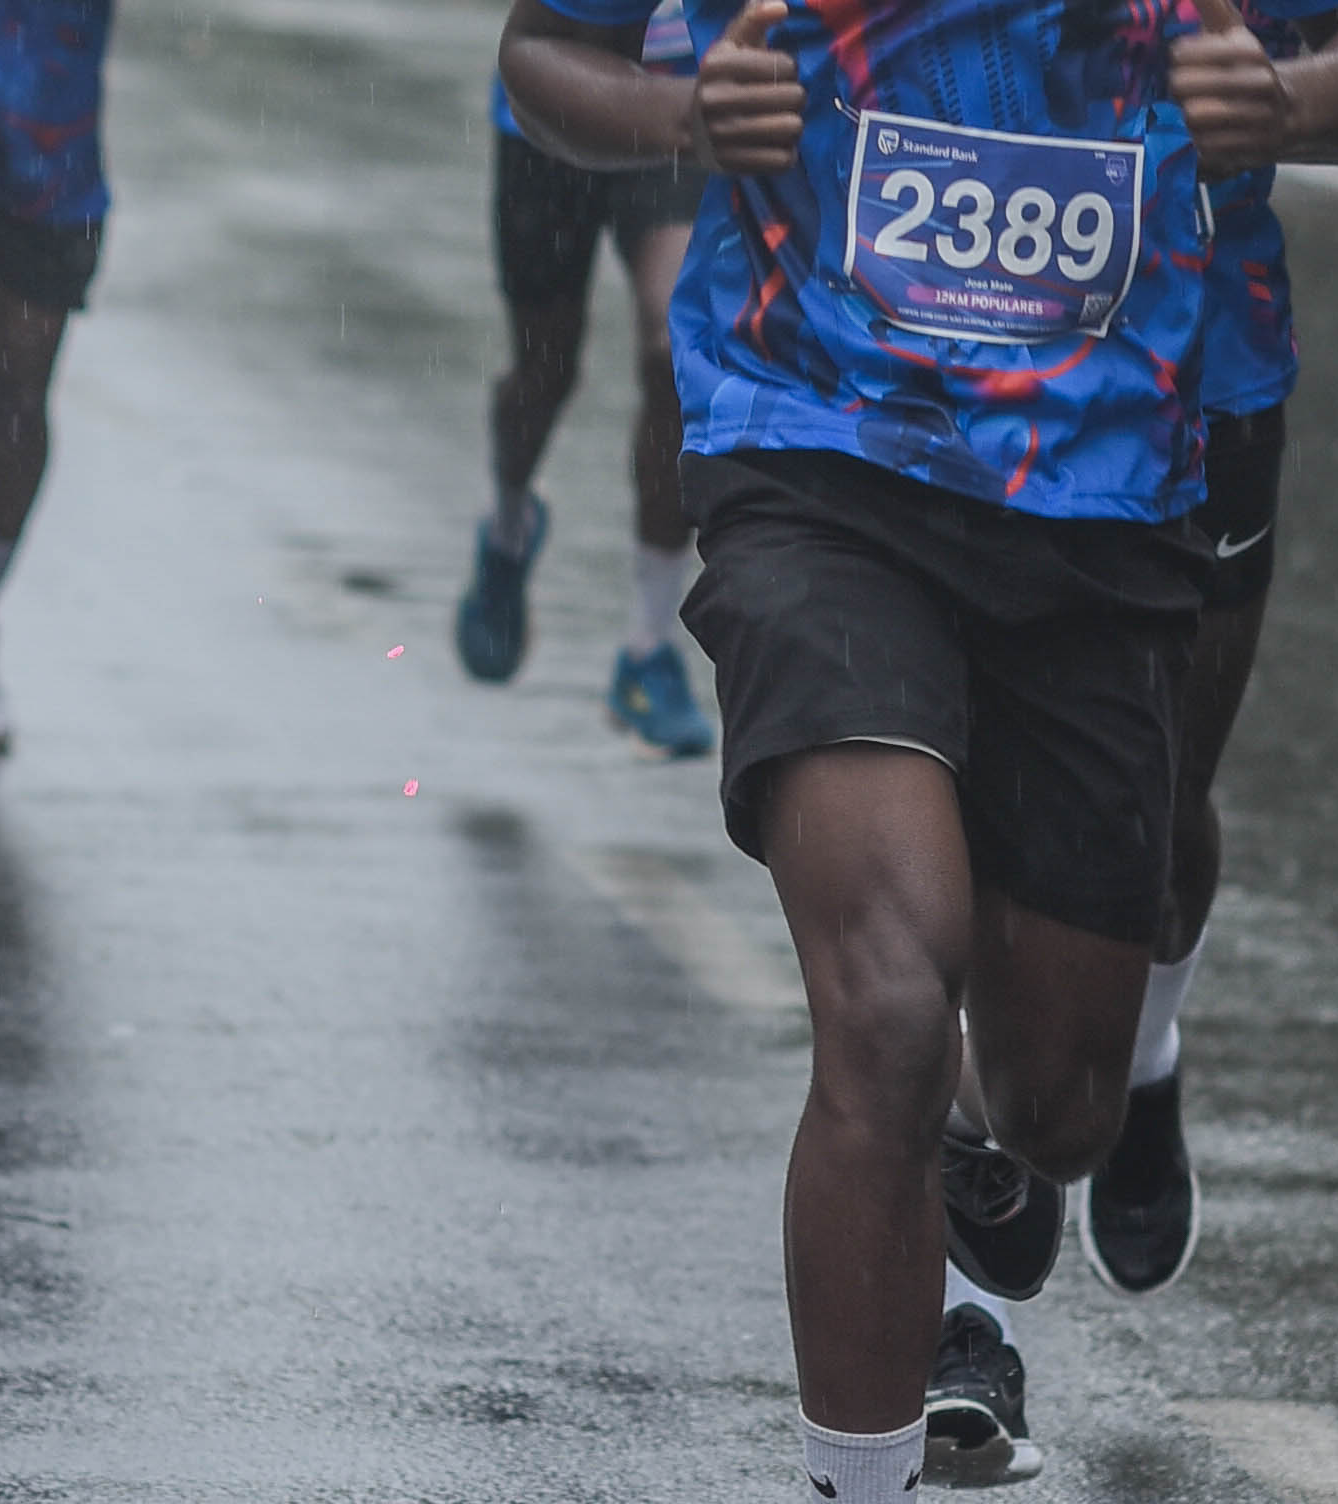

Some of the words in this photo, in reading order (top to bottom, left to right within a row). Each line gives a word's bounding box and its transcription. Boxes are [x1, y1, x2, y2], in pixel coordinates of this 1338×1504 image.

[902, 138, 950, 158] Standard
[951, 147, 978, 163] Bank
[874, 170, 1114, 281] 2389
[935, 289, 969, 308] 12KM
[971, 294, 1044, 315] POPULARES
